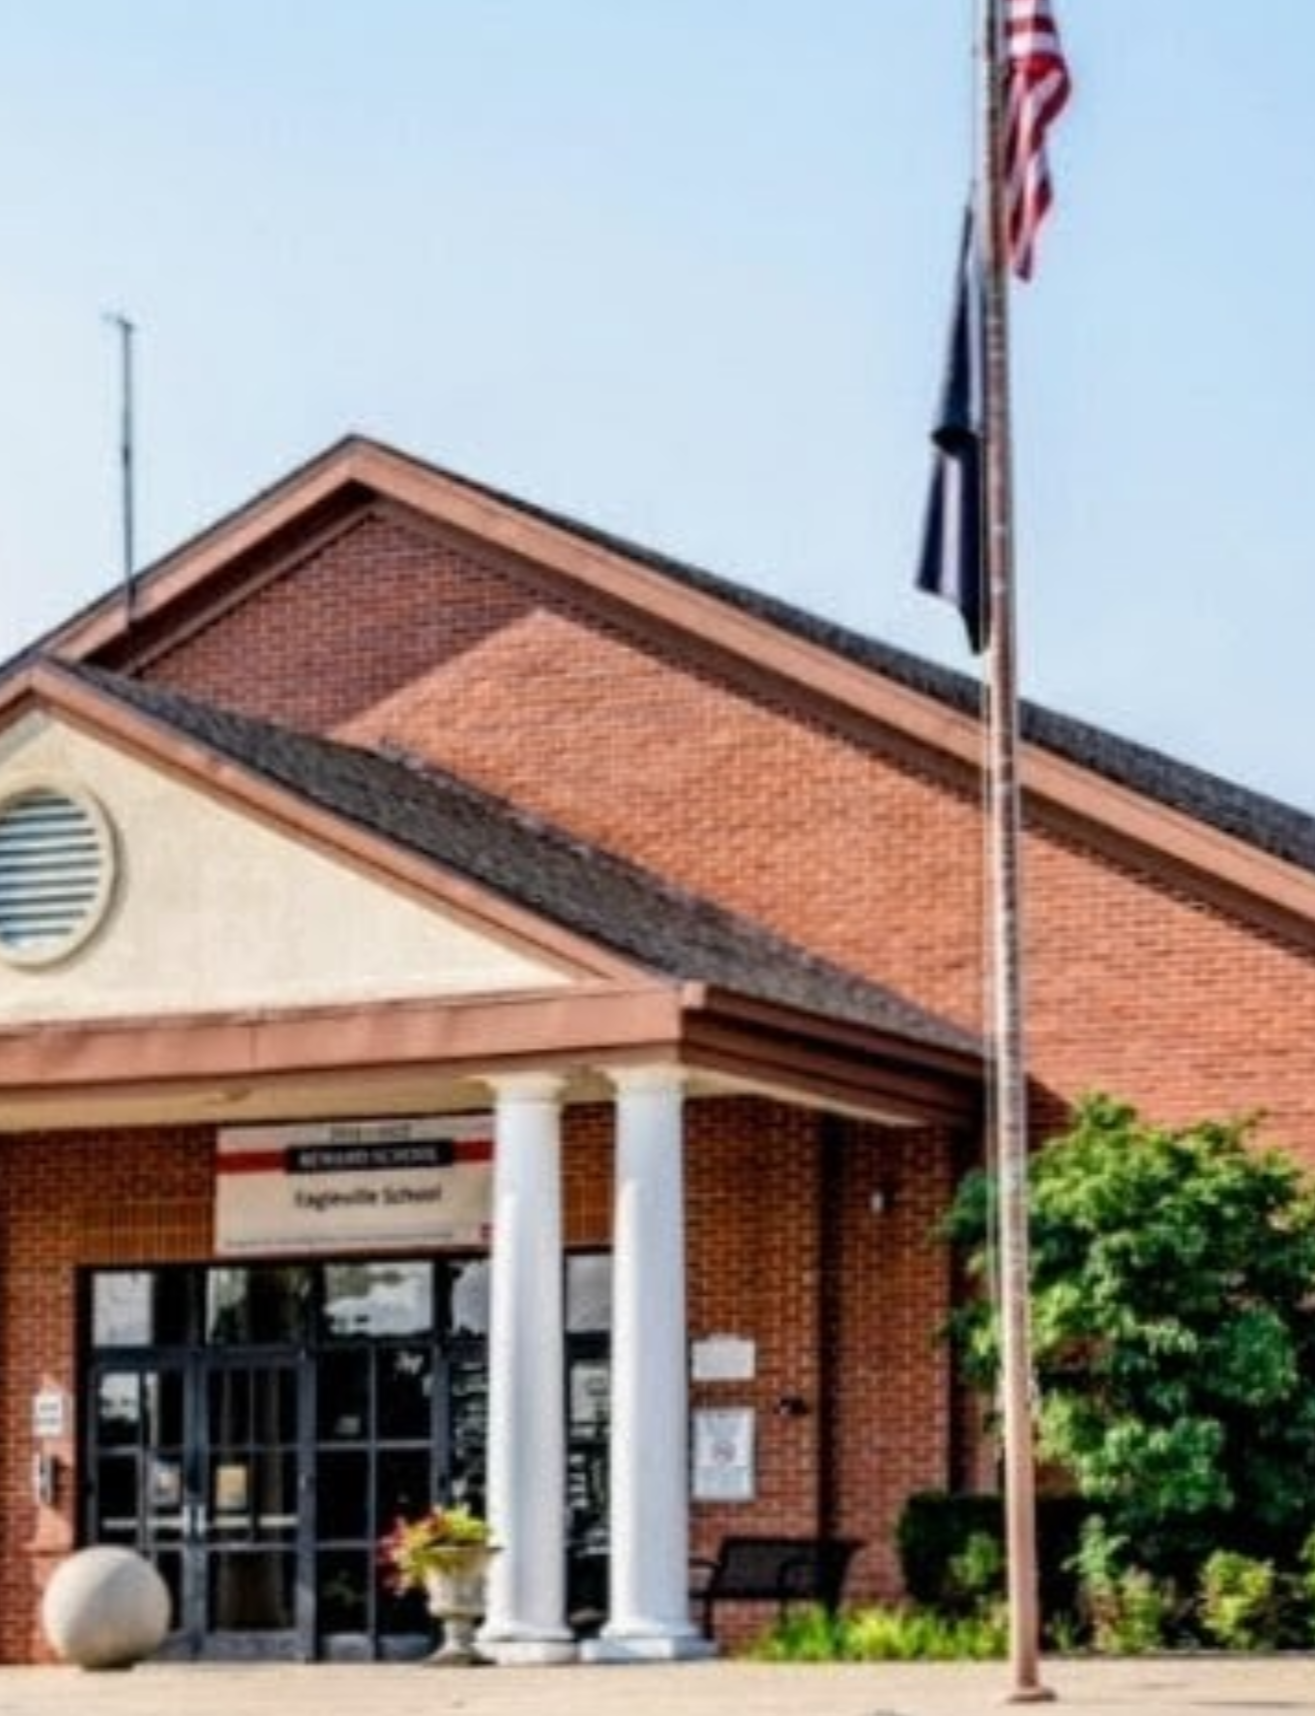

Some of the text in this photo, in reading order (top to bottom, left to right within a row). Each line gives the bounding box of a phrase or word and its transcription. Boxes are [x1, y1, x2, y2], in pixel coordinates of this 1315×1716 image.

[298, 1146, 439, 1169] REWARD SCHOOL
[294, 1183, 442, 1212] Eagleville School
